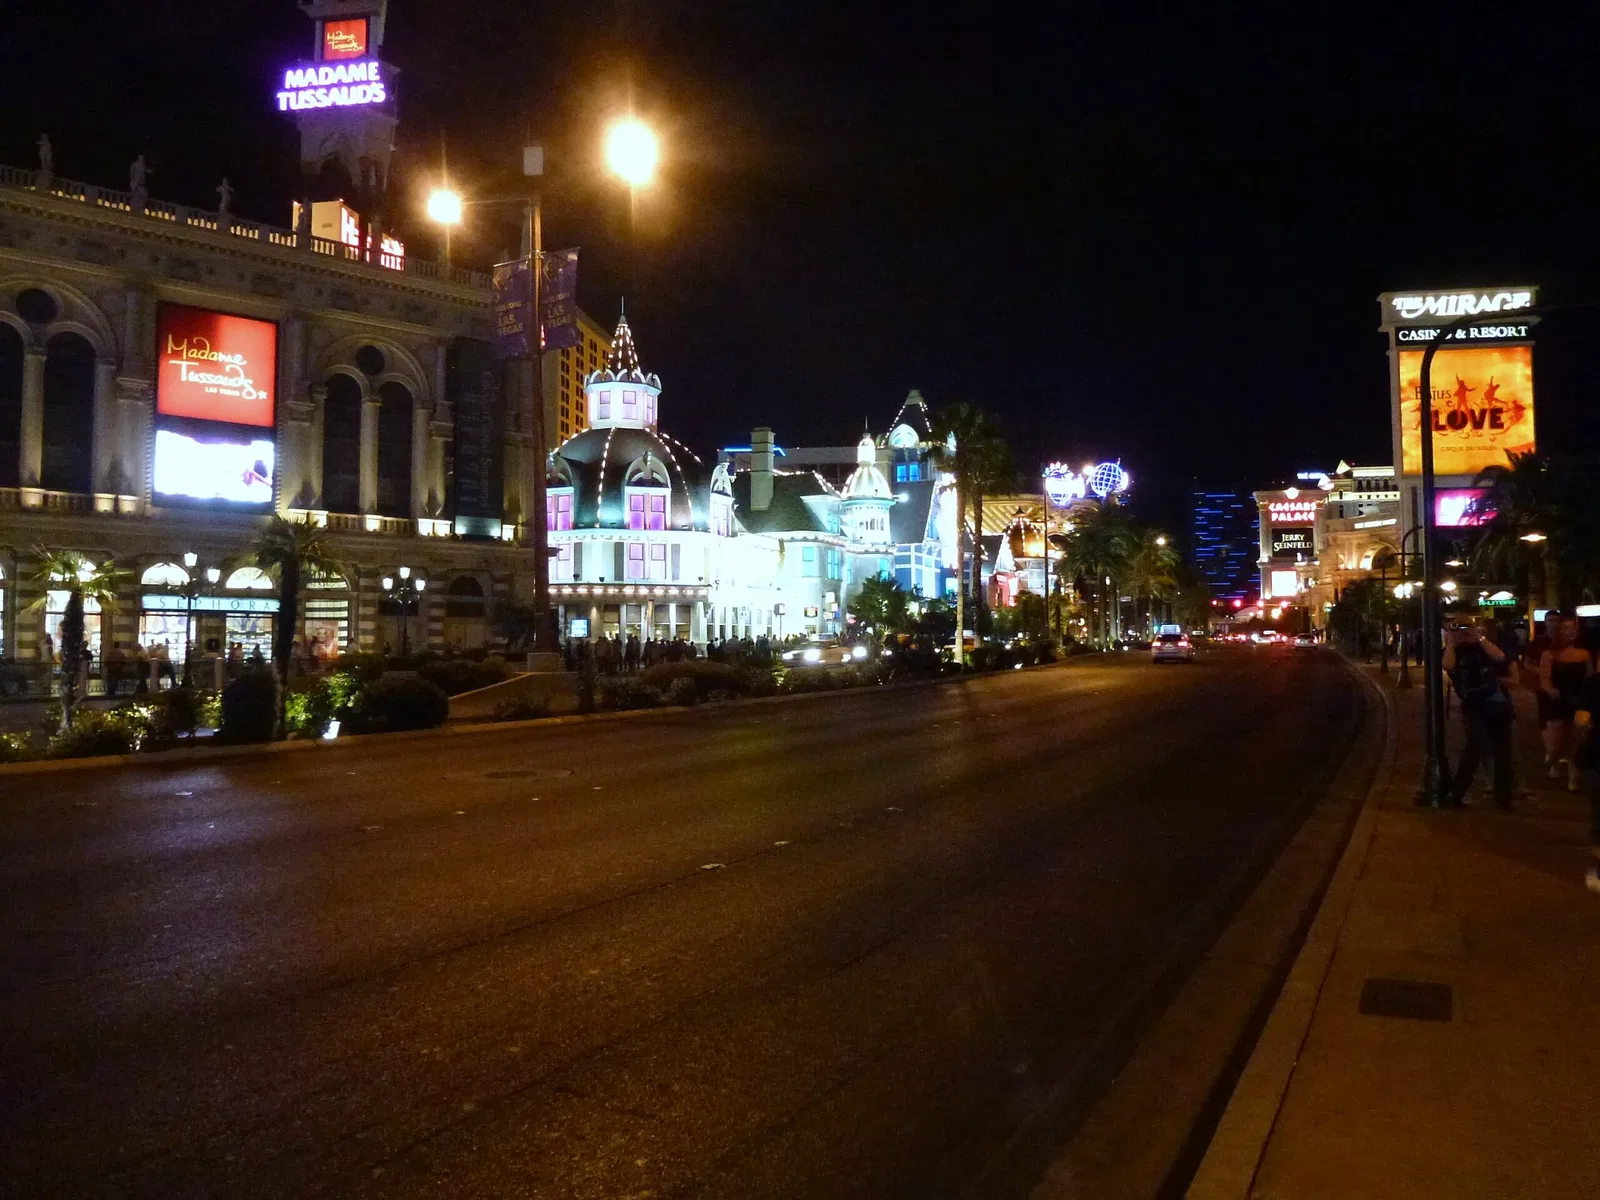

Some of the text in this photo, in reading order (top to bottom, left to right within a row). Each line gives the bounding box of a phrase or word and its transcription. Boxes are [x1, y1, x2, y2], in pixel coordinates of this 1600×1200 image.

[285, 62, 380, 89] MADAME
[548, 305, 564, 319] LAS
[1401, 292, 1530, 318] MIRAGE
[499, 313, 516, 327] LAS
[1398, 326, 1528, 341] CASIN & RESORT
[168, 334, 248, 365] Madame
[1414, 386, 1452, 401] BTLES
[1432, 408, 1504, 431] LOVE
[1268, 502, 1317, 512] CAESARS
[1272, 511, 1316, 521] PALACE
[1281, 533, 1305, 543] JERRY
[1273, 541, 1313, 552] SEINFELD
[159, 597, 272, 611] SEPHORA
